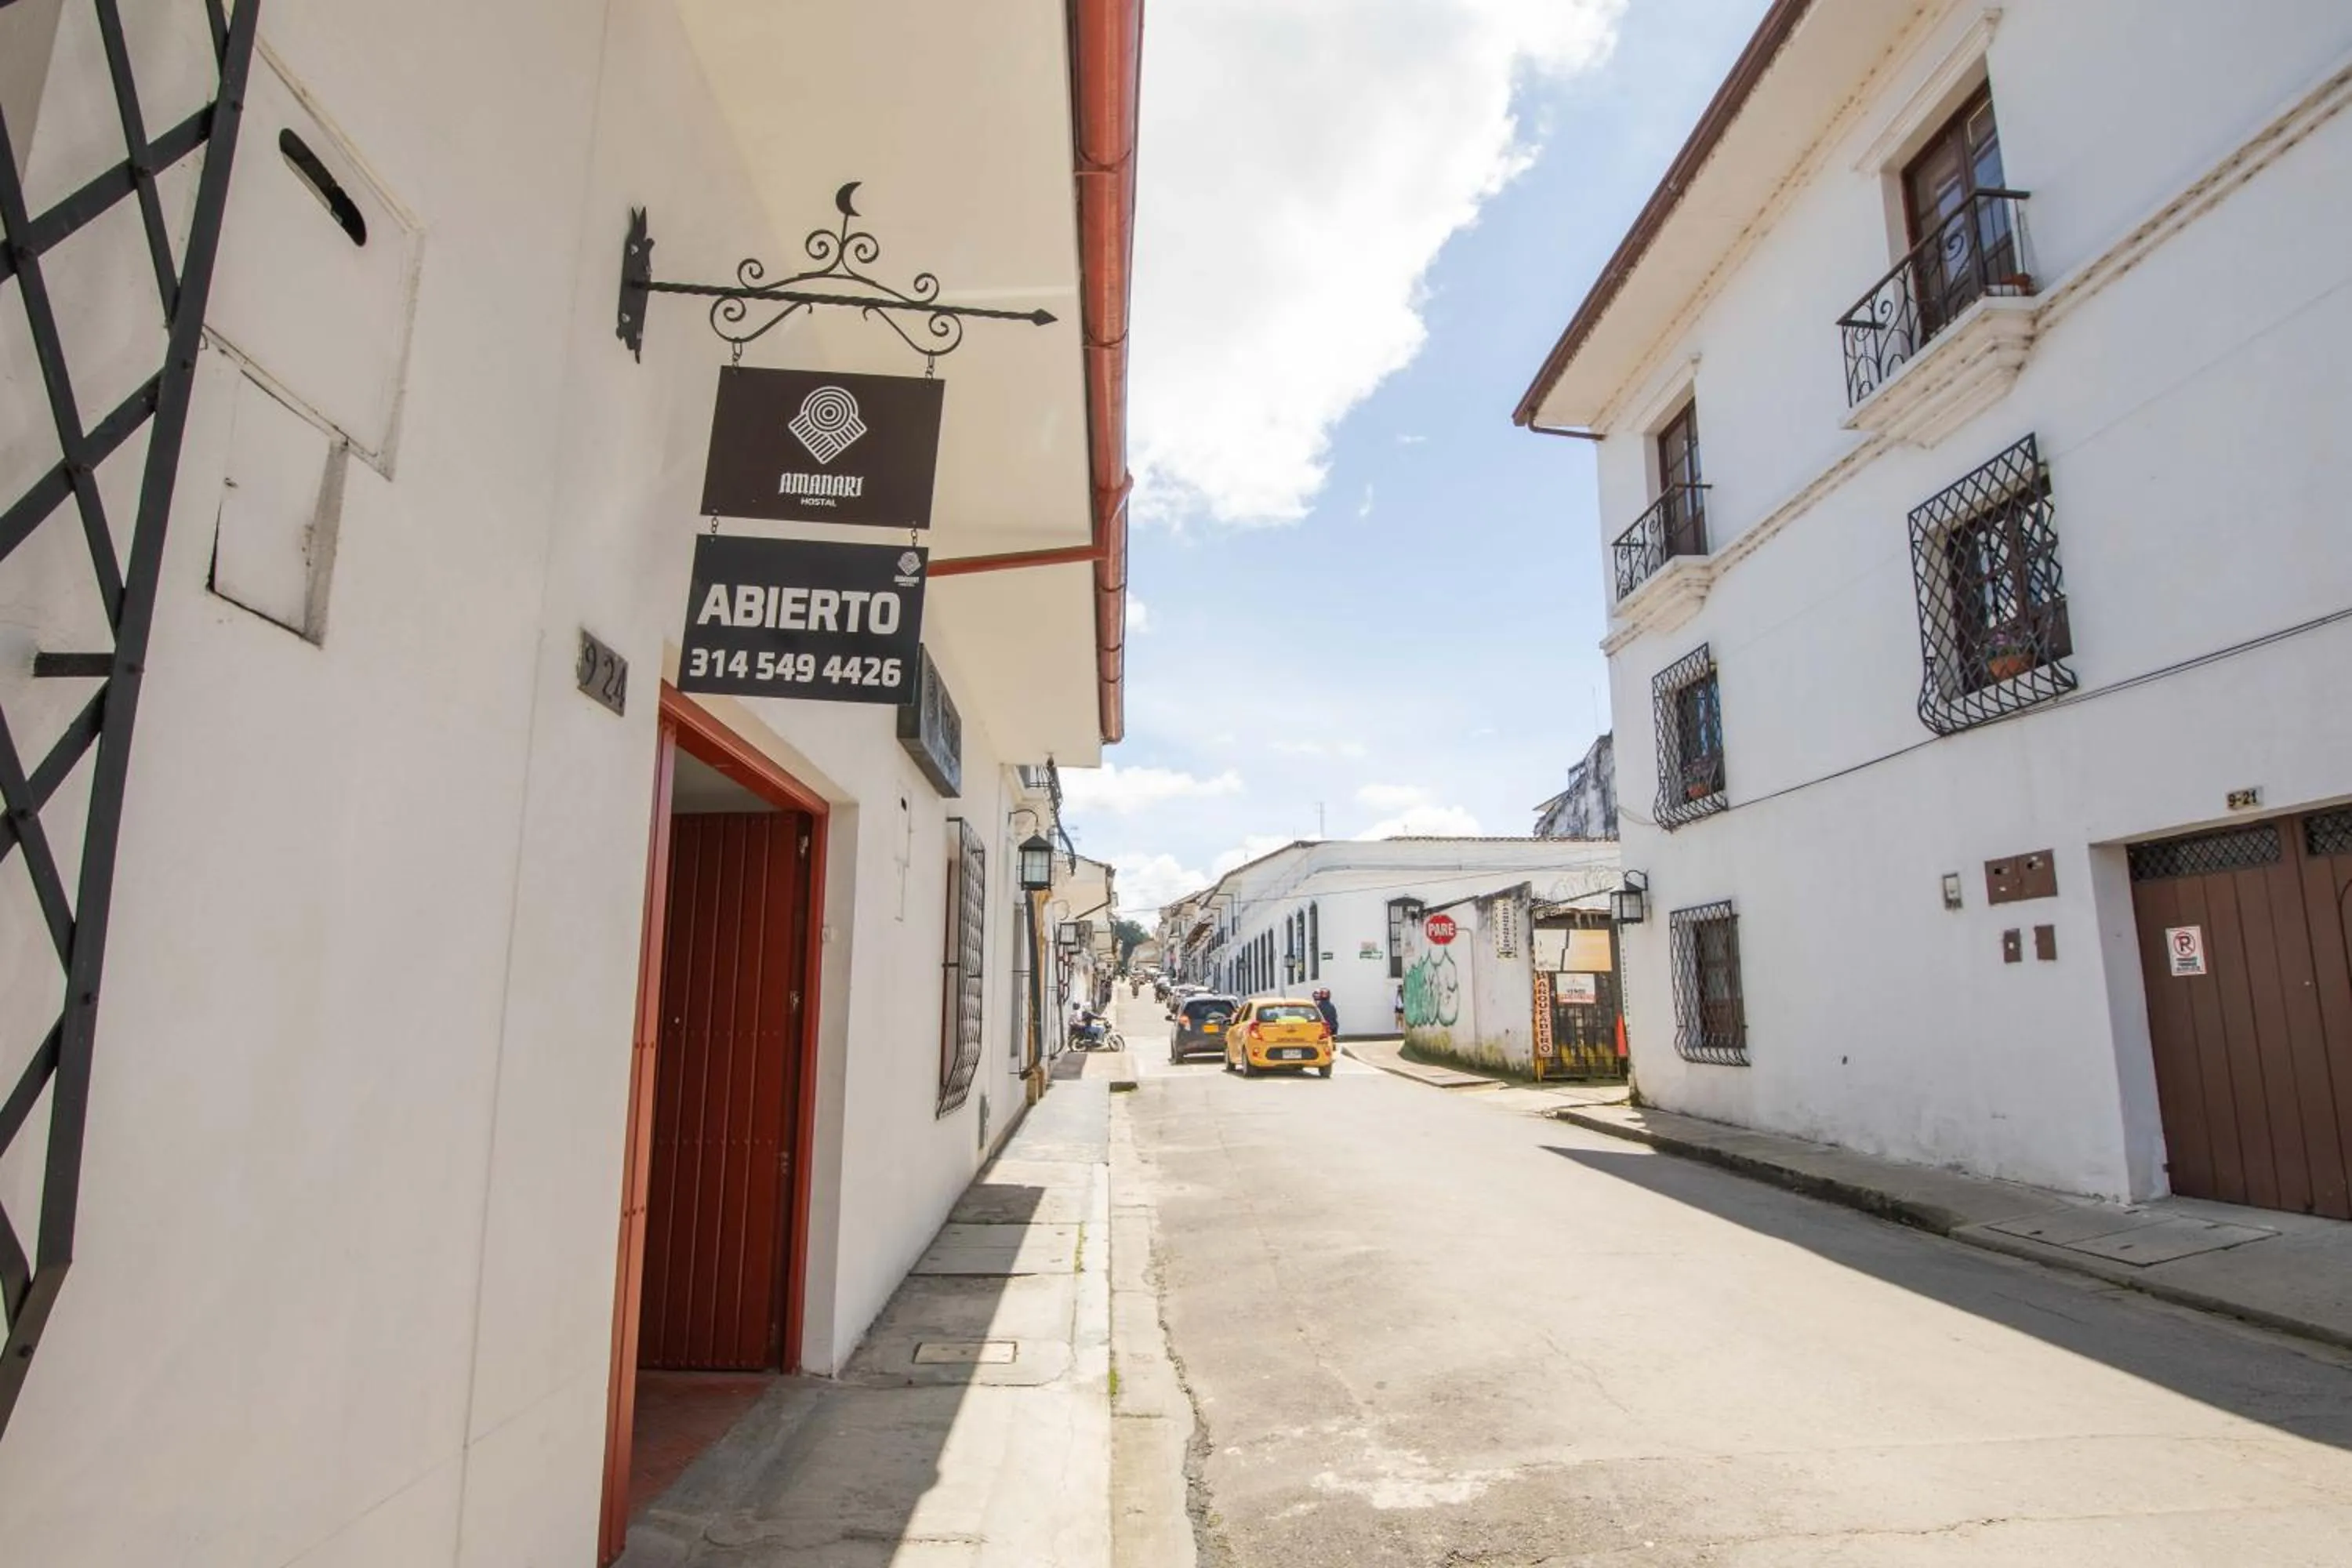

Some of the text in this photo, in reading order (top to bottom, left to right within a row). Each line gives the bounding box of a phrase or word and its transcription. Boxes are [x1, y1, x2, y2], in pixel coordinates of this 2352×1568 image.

[779, 472, 864, 497] AMANARI
[800, 498, 837, 507] HOSTAL
[697, 583, 901, 635] ABIERTO
[689, 648, 902, 688] 314 549 4426
[2227, 789, 2257, 807] 9-21
[1428, 923, 1455, 938] PARE
